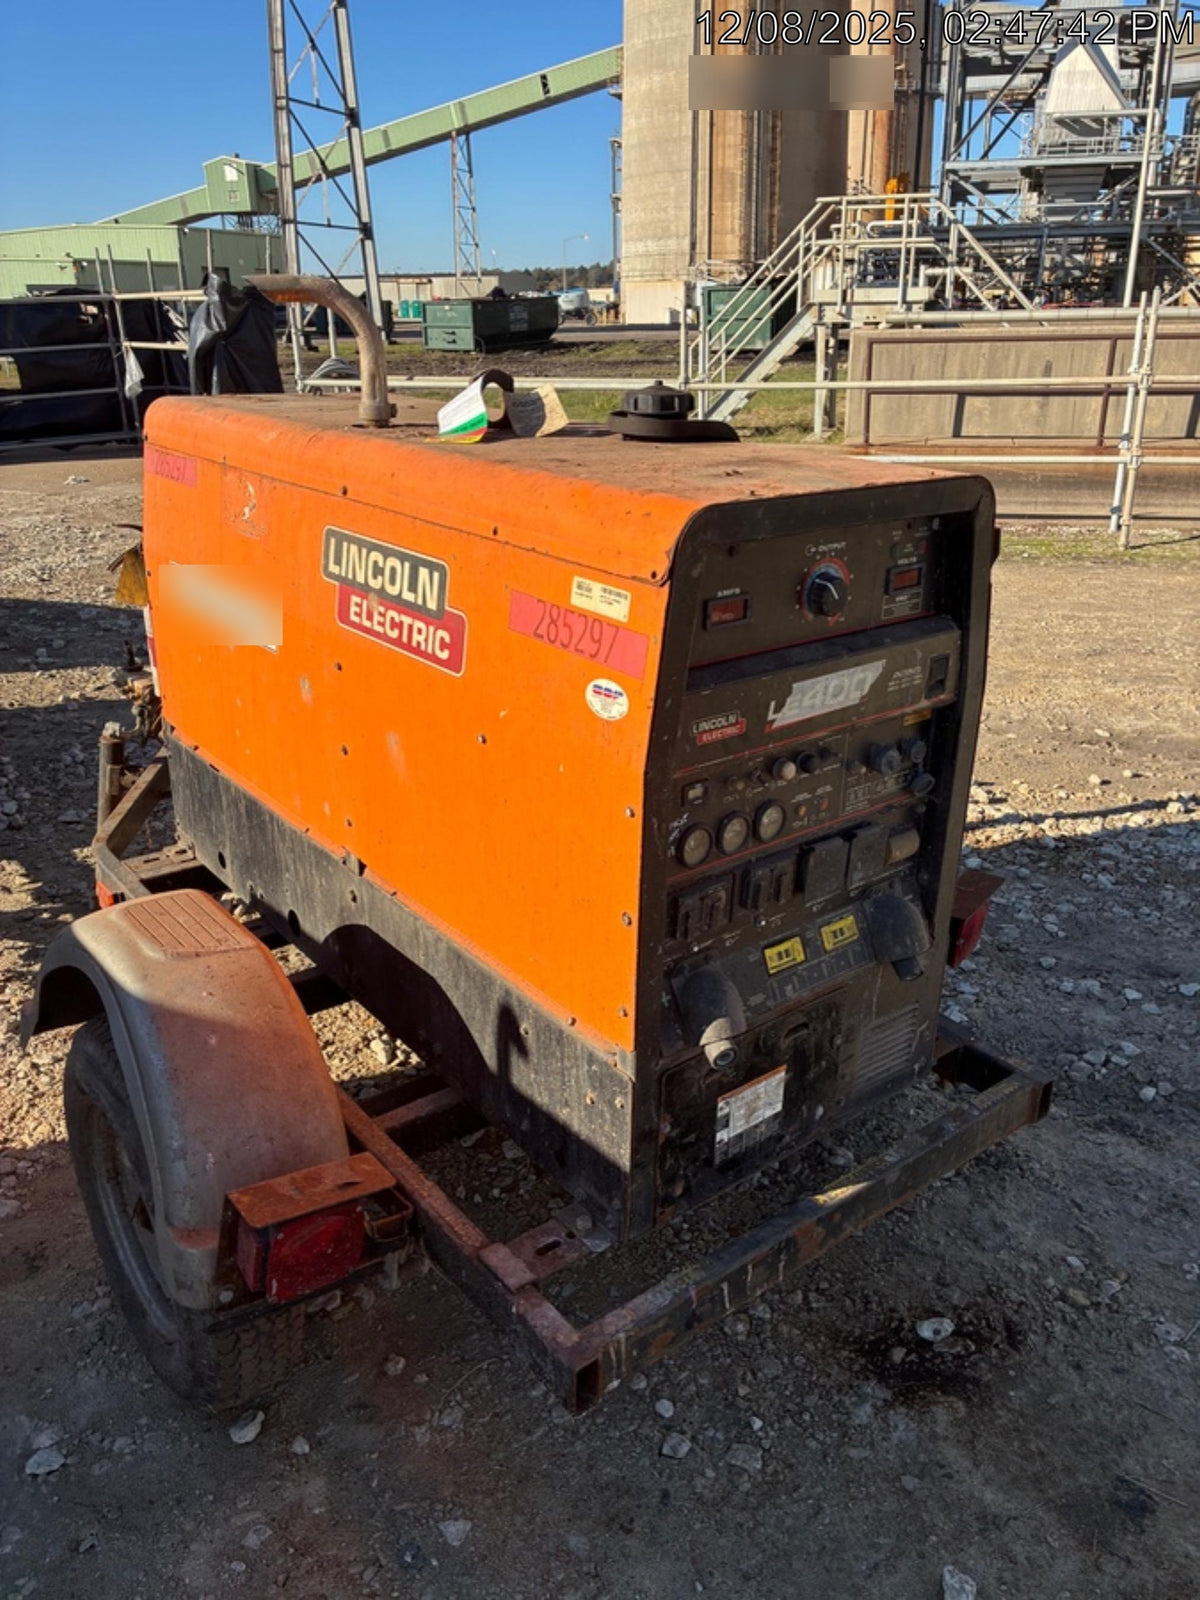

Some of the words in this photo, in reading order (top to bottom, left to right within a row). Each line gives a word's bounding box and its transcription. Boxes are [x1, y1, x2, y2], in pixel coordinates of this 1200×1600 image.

[328, 537, 440, 612] LINCOLN
[349, 594, 451, 661] ELECTRIC
[533, 598, 619, 664] 285297
[693, 713, 737, 734] LINCOLN
[702, 724, 741, 743] ELECTRIC
